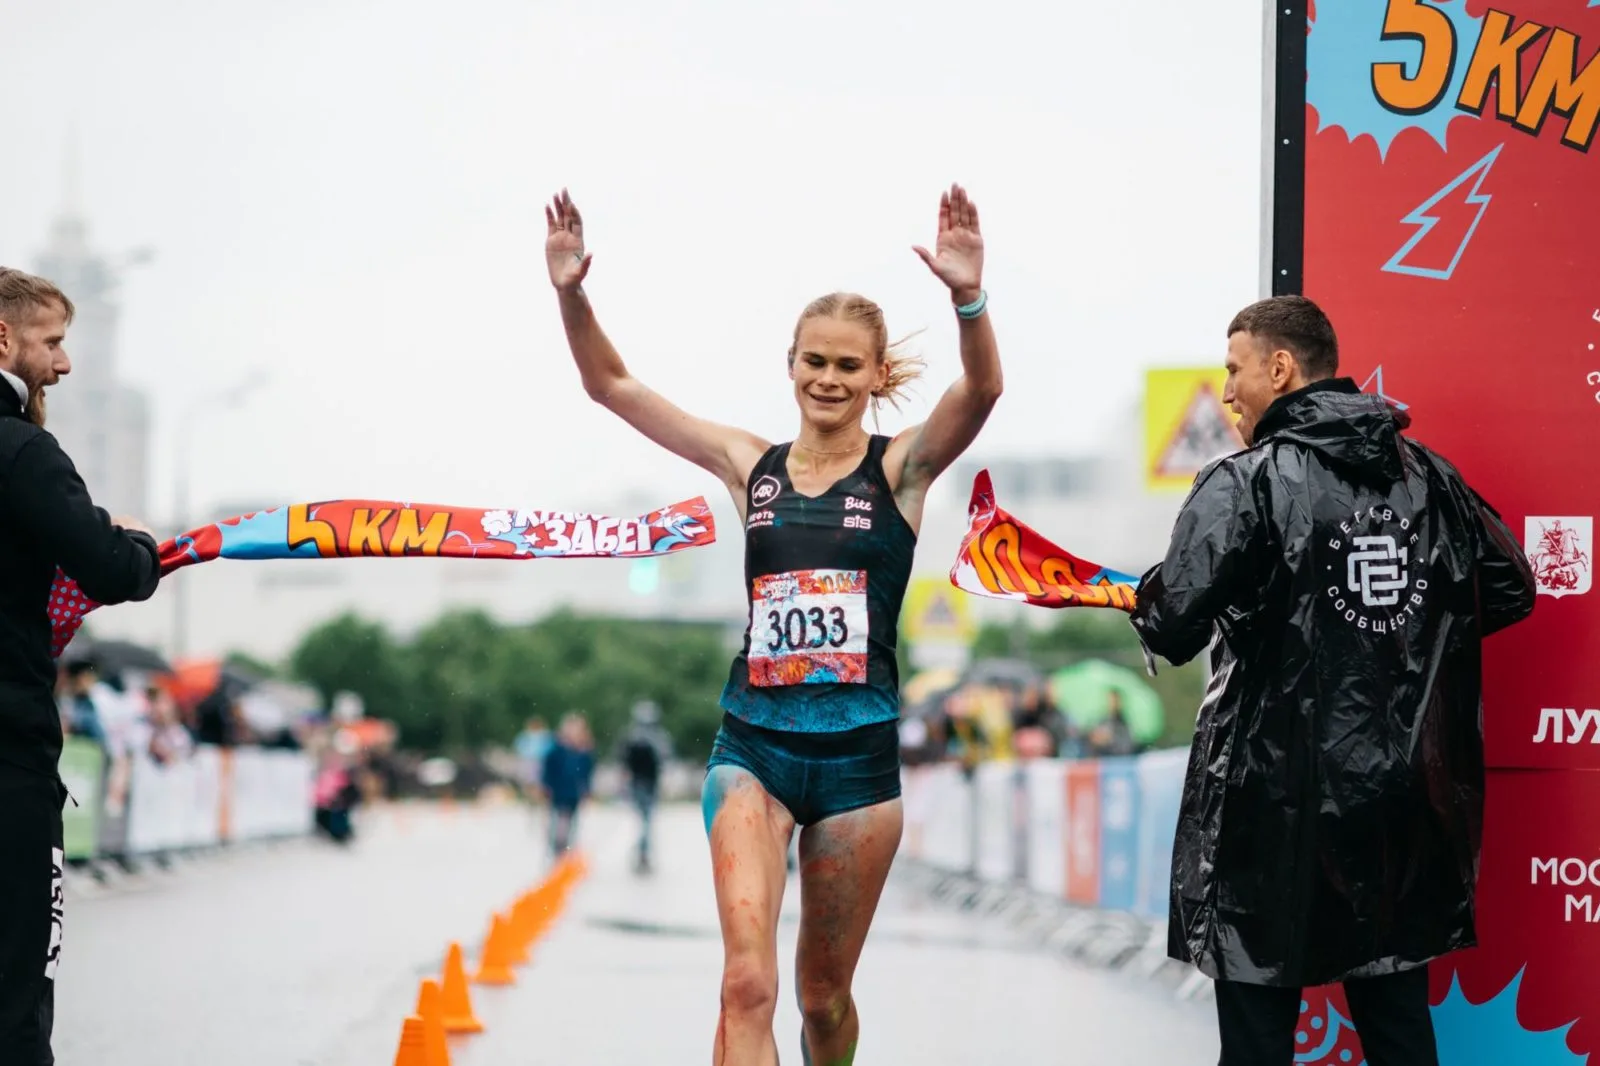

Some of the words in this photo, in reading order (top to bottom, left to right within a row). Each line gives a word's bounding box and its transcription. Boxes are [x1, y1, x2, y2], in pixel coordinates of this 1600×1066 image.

[767, 606, 849, 652] 3033
[1327, 578, 1428, 635] СООБЩЕСТВО
[1564, 894, 1600, 922] М
